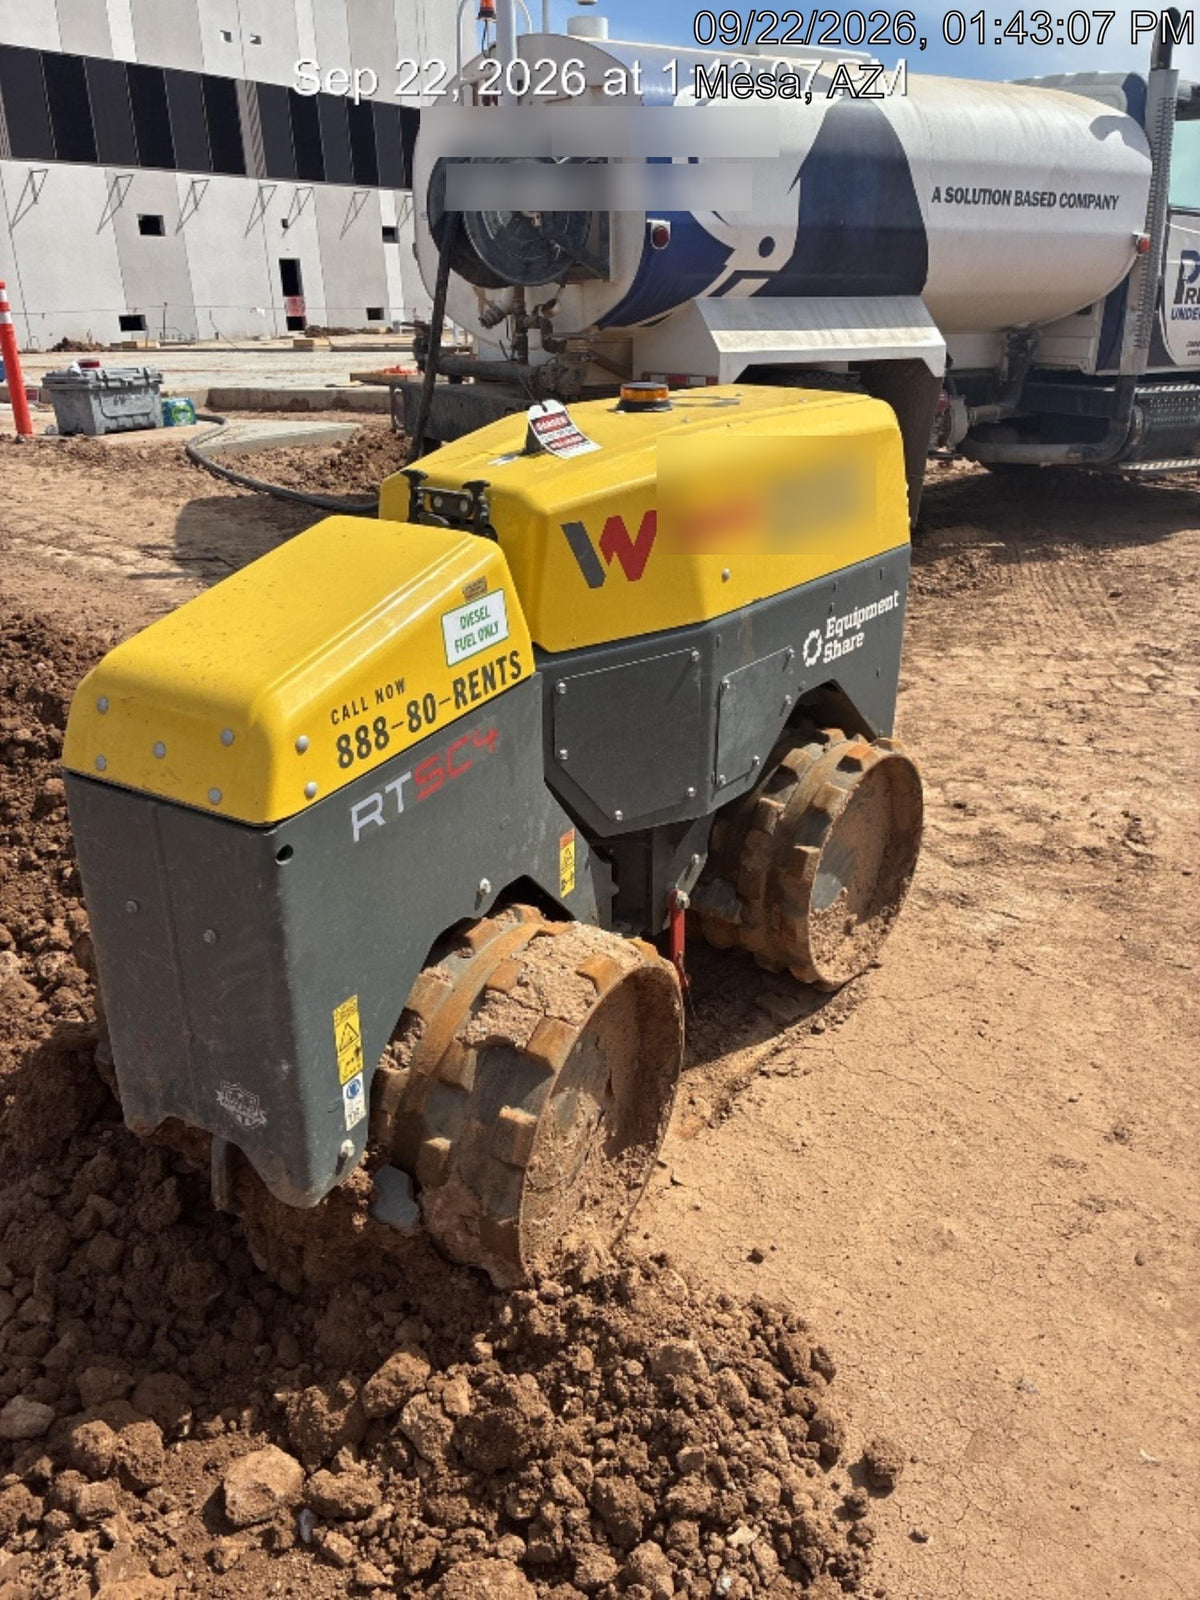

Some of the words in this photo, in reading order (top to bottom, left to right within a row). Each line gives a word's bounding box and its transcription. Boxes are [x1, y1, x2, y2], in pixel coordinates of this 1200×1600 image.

[931, 186, 942, 203] A
[944, 187, 1013, 206] SOLUTION
[1014, 190, 1057, 207] BASED
[1059, 192, 1120, 211] COMPANY
[1171, 307, 1200, 320] UNDE
[460, 605, 491, 630] DIESEL
[825, 590, 900, 640] Equipment
[454, 635, 477, 654] FUEL
[477, 621, 499, 644] ONLY
[822, 630, 865, 665] Share
[331, 697, 369, 725] CALL
[375, 677, 407, 705] NOW
[336, 650, 523, 769] 888-80-RENTS
